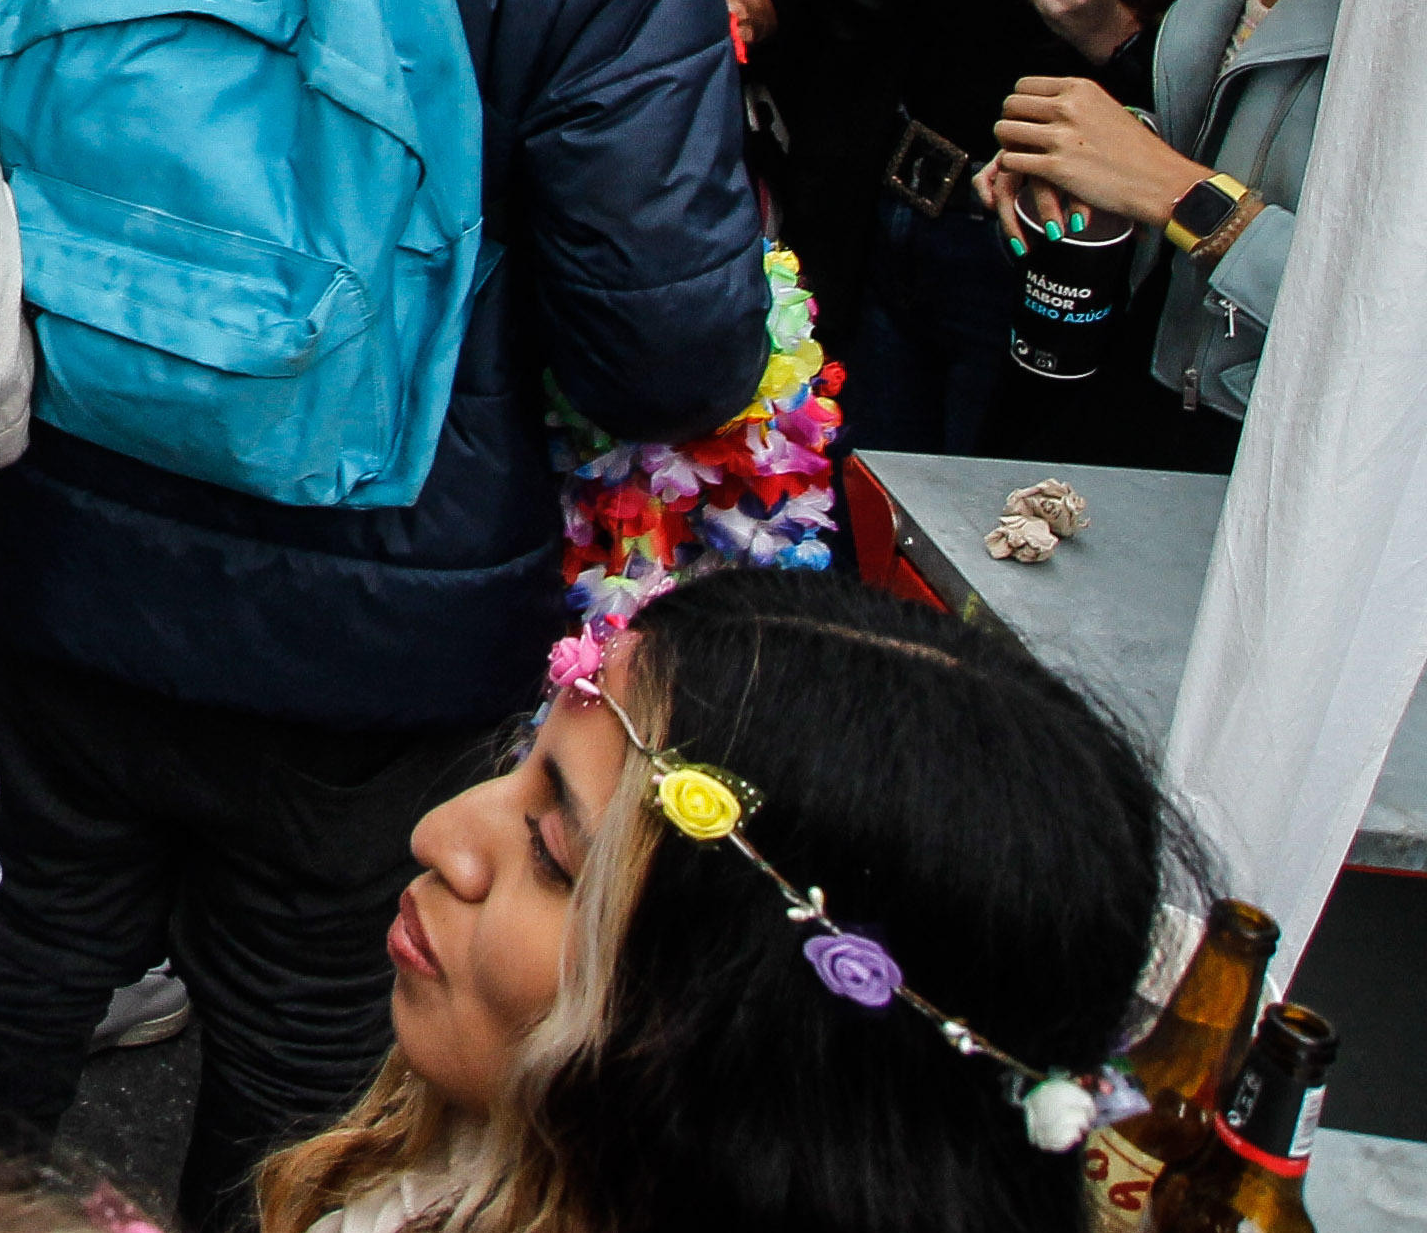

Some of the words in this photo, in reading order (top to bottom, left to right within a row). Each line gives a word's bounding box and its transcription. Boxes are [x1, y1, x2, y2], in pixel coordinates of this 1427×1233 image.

[1025, 284, 1075, 310] SABOR
[1027, 270, 1091, 299] MÁXIMO
[1024, 297, 1060, 319] ZERO
[1063, 303, 1113, 323] AZÚCA
